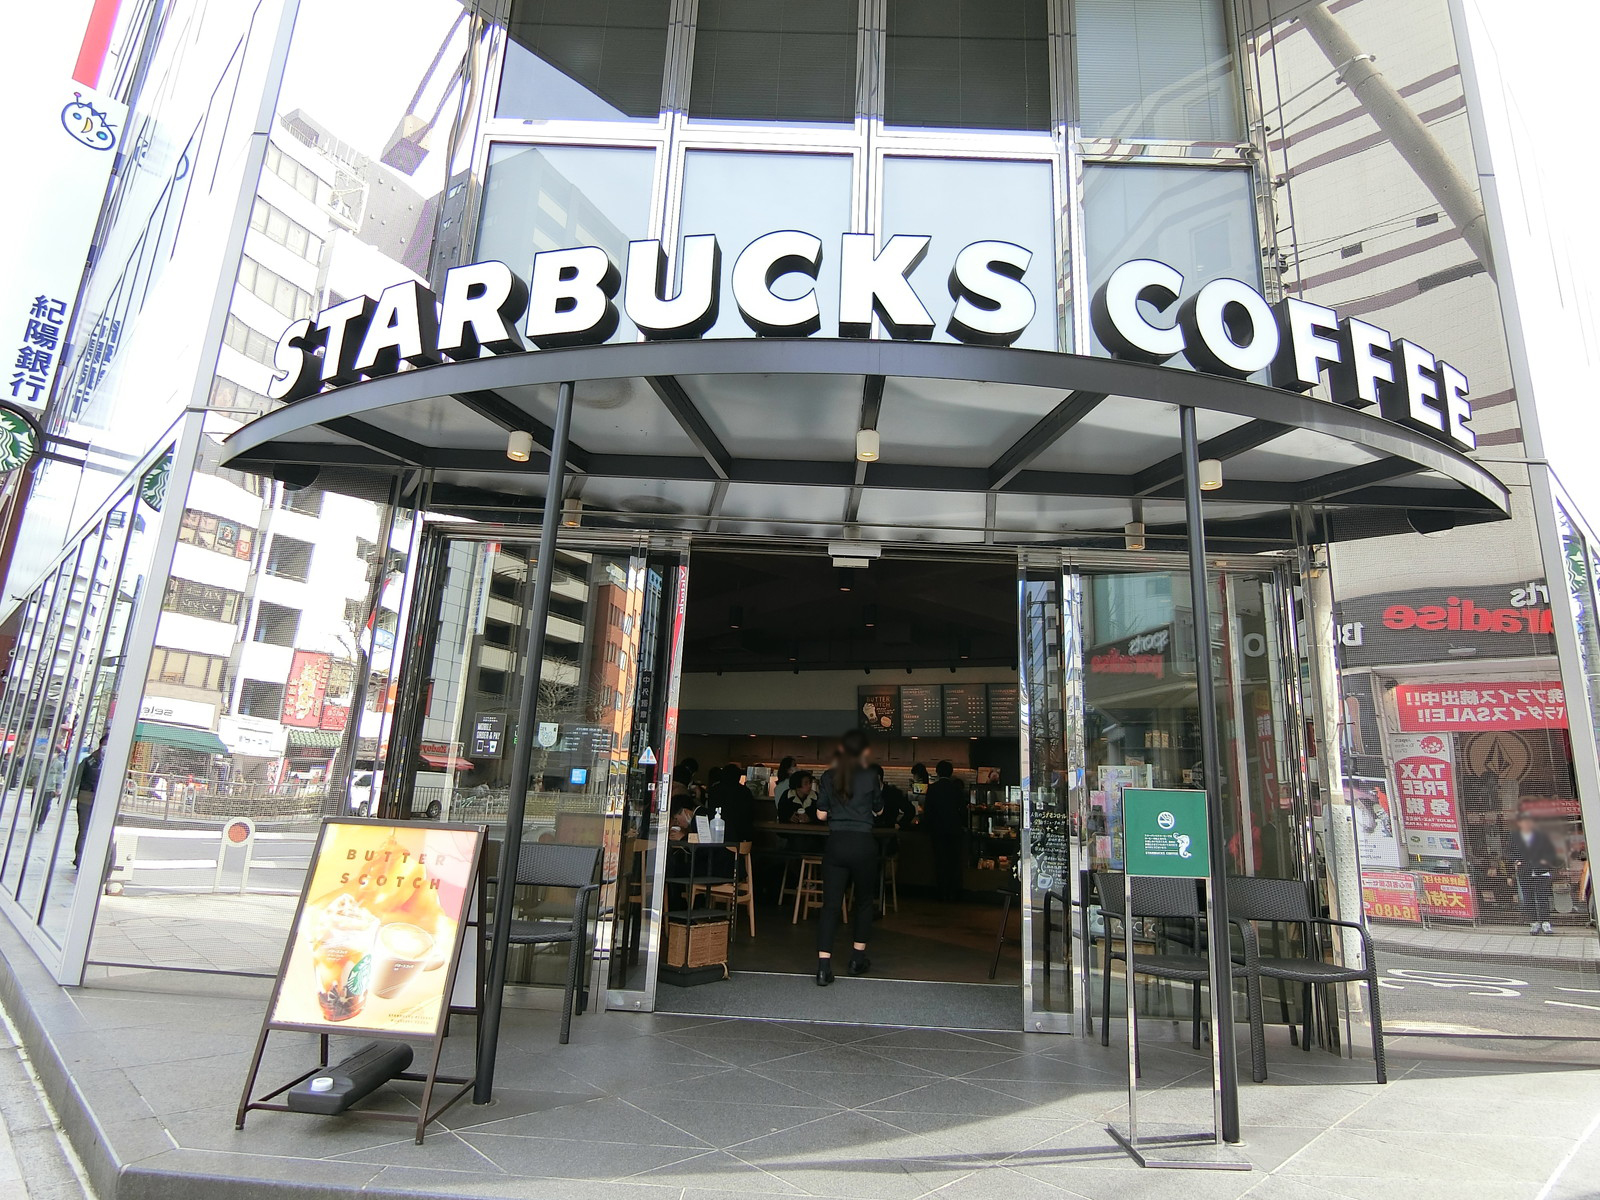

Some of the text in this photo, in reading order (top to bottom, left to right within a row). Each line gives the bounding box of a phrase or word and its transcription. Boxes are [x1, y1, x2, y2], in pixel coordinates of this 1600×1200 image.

[10, 294, 67, 402] 紀陽銀行
[268, 229, 1036, 403] STARBUCKS
[1093, 257, 1476, 452] COFFEE
[340, 872, 441, 890] SCOTCH
[347, 848, 444, 867] BUTTER
